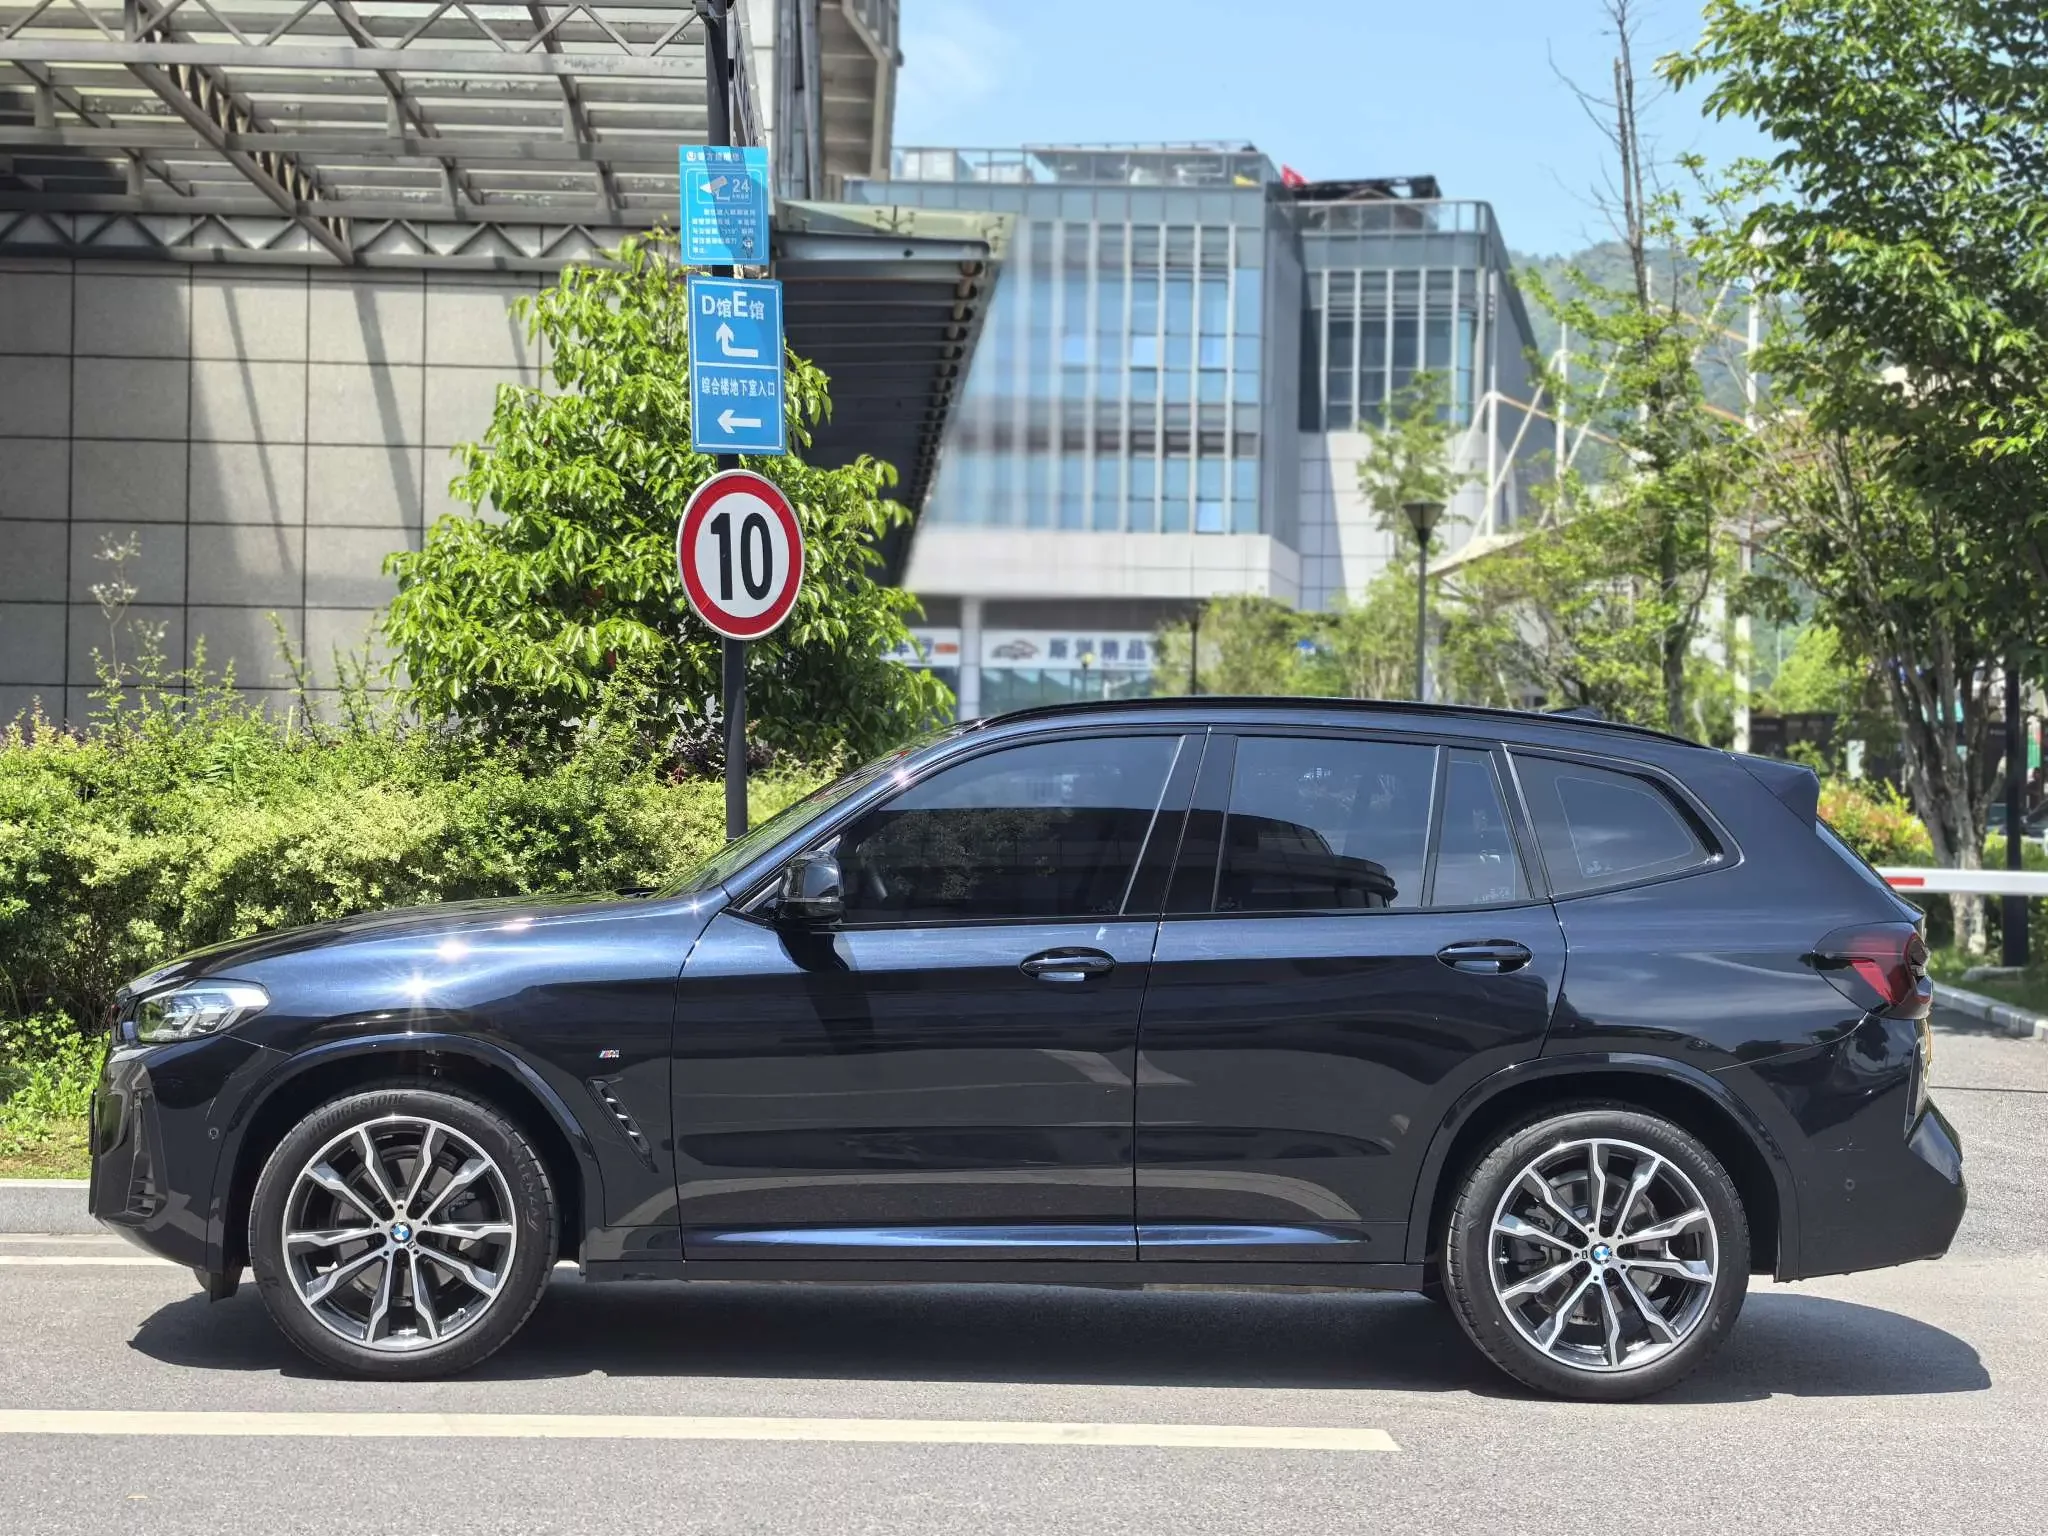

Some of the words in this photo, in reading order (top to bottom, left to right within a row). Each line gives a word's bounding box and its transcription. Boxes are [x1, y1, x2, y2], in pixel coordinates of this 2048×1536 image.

[732, 178, 751, 193] 24
[701, 290, 765, 321] D馆E馆
[701, 376, 776, 398] 综合楼地下室入口
[710, 512, 774, 601] 10
